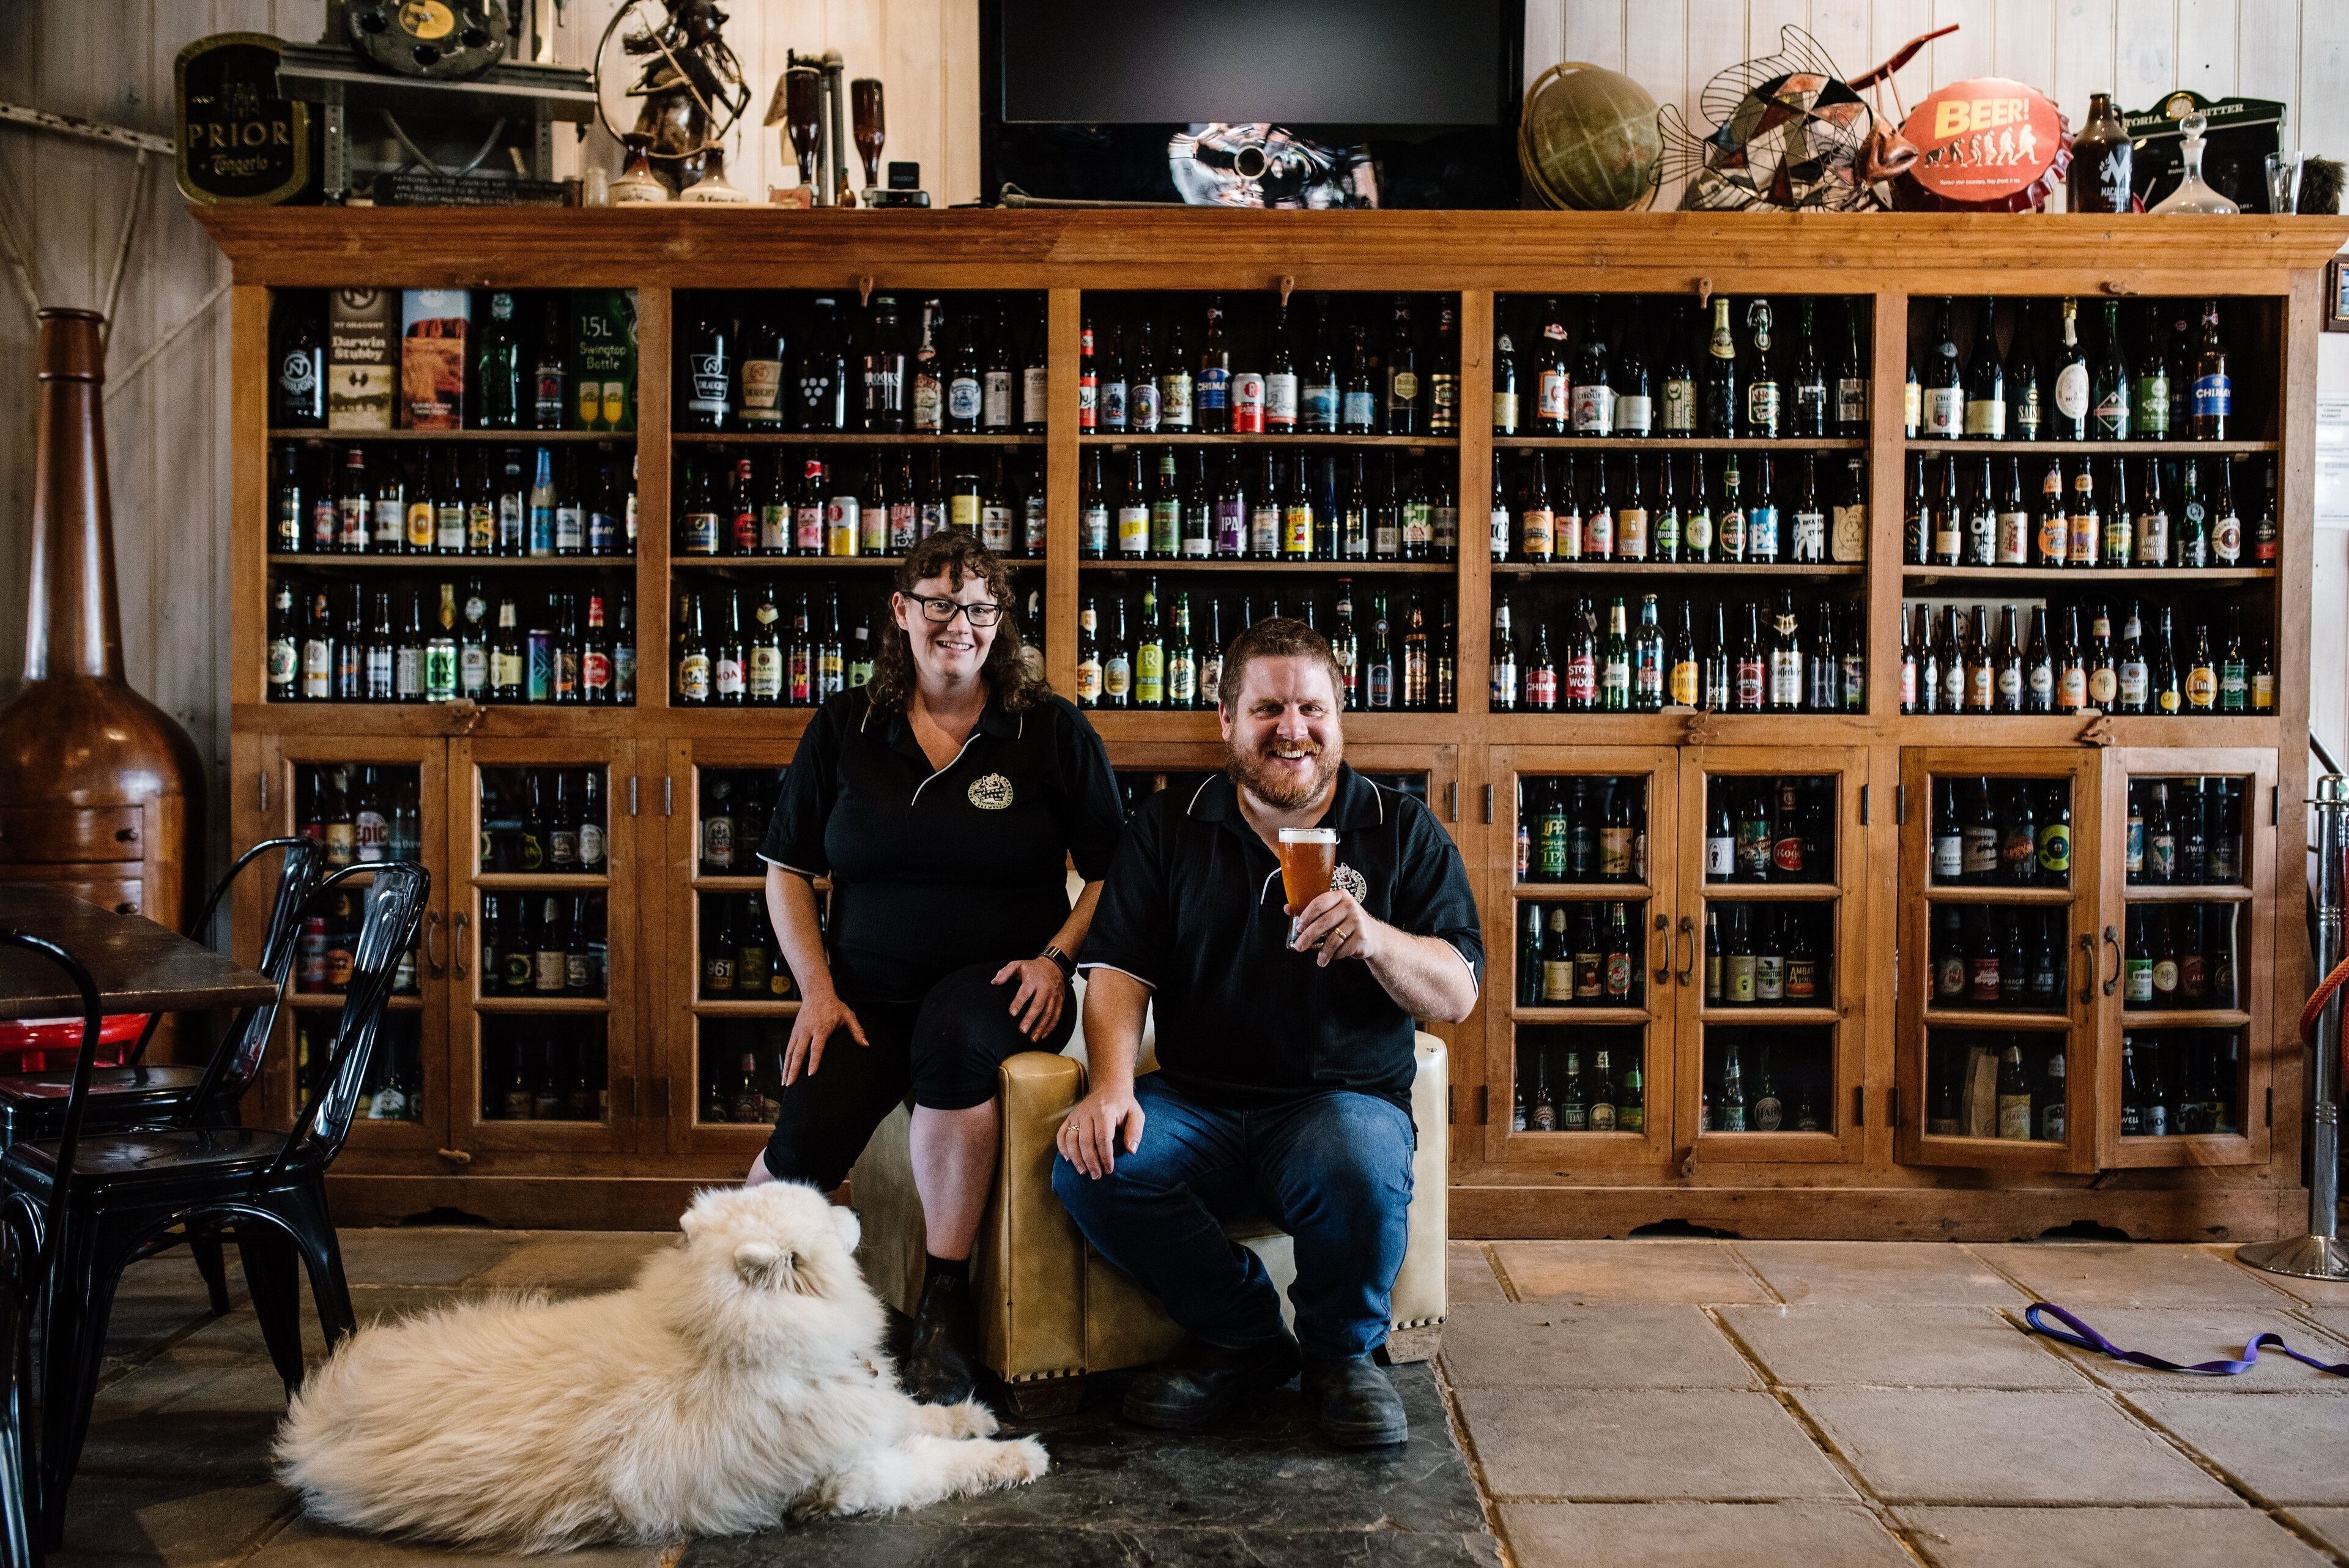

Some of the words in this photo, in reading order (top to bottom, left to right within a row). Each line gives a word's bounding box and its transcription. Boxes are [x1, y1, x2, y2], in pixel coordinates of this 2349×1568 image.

[1934, 98, 2030, 140] BEER!
[2123, 114, 2162, 128] TORIA
[2199, 103, 2244, 117] BITTER
[187, 120, 289, 148] PRIOR
[332, 336, 387, 349] Darwin
[333, 347, 383, 362] Stubby
[579, 342, 627, 359] Swingtop
[585, 357, 621, 371] Bottle
[2195, 388, 2231, 401] CHIMAY
[1222, 516, 1239, 532] IPA
[1568, 665, 1595, 677] STONE
[1568, 677, 1595, 688] WOOD
[356, 826, 386, 847] Epic
[1543, 852, 1567, 863] IPA
[707, 961, 732, 978] 961
[1570, 1112, 1586, 1124] DAB
